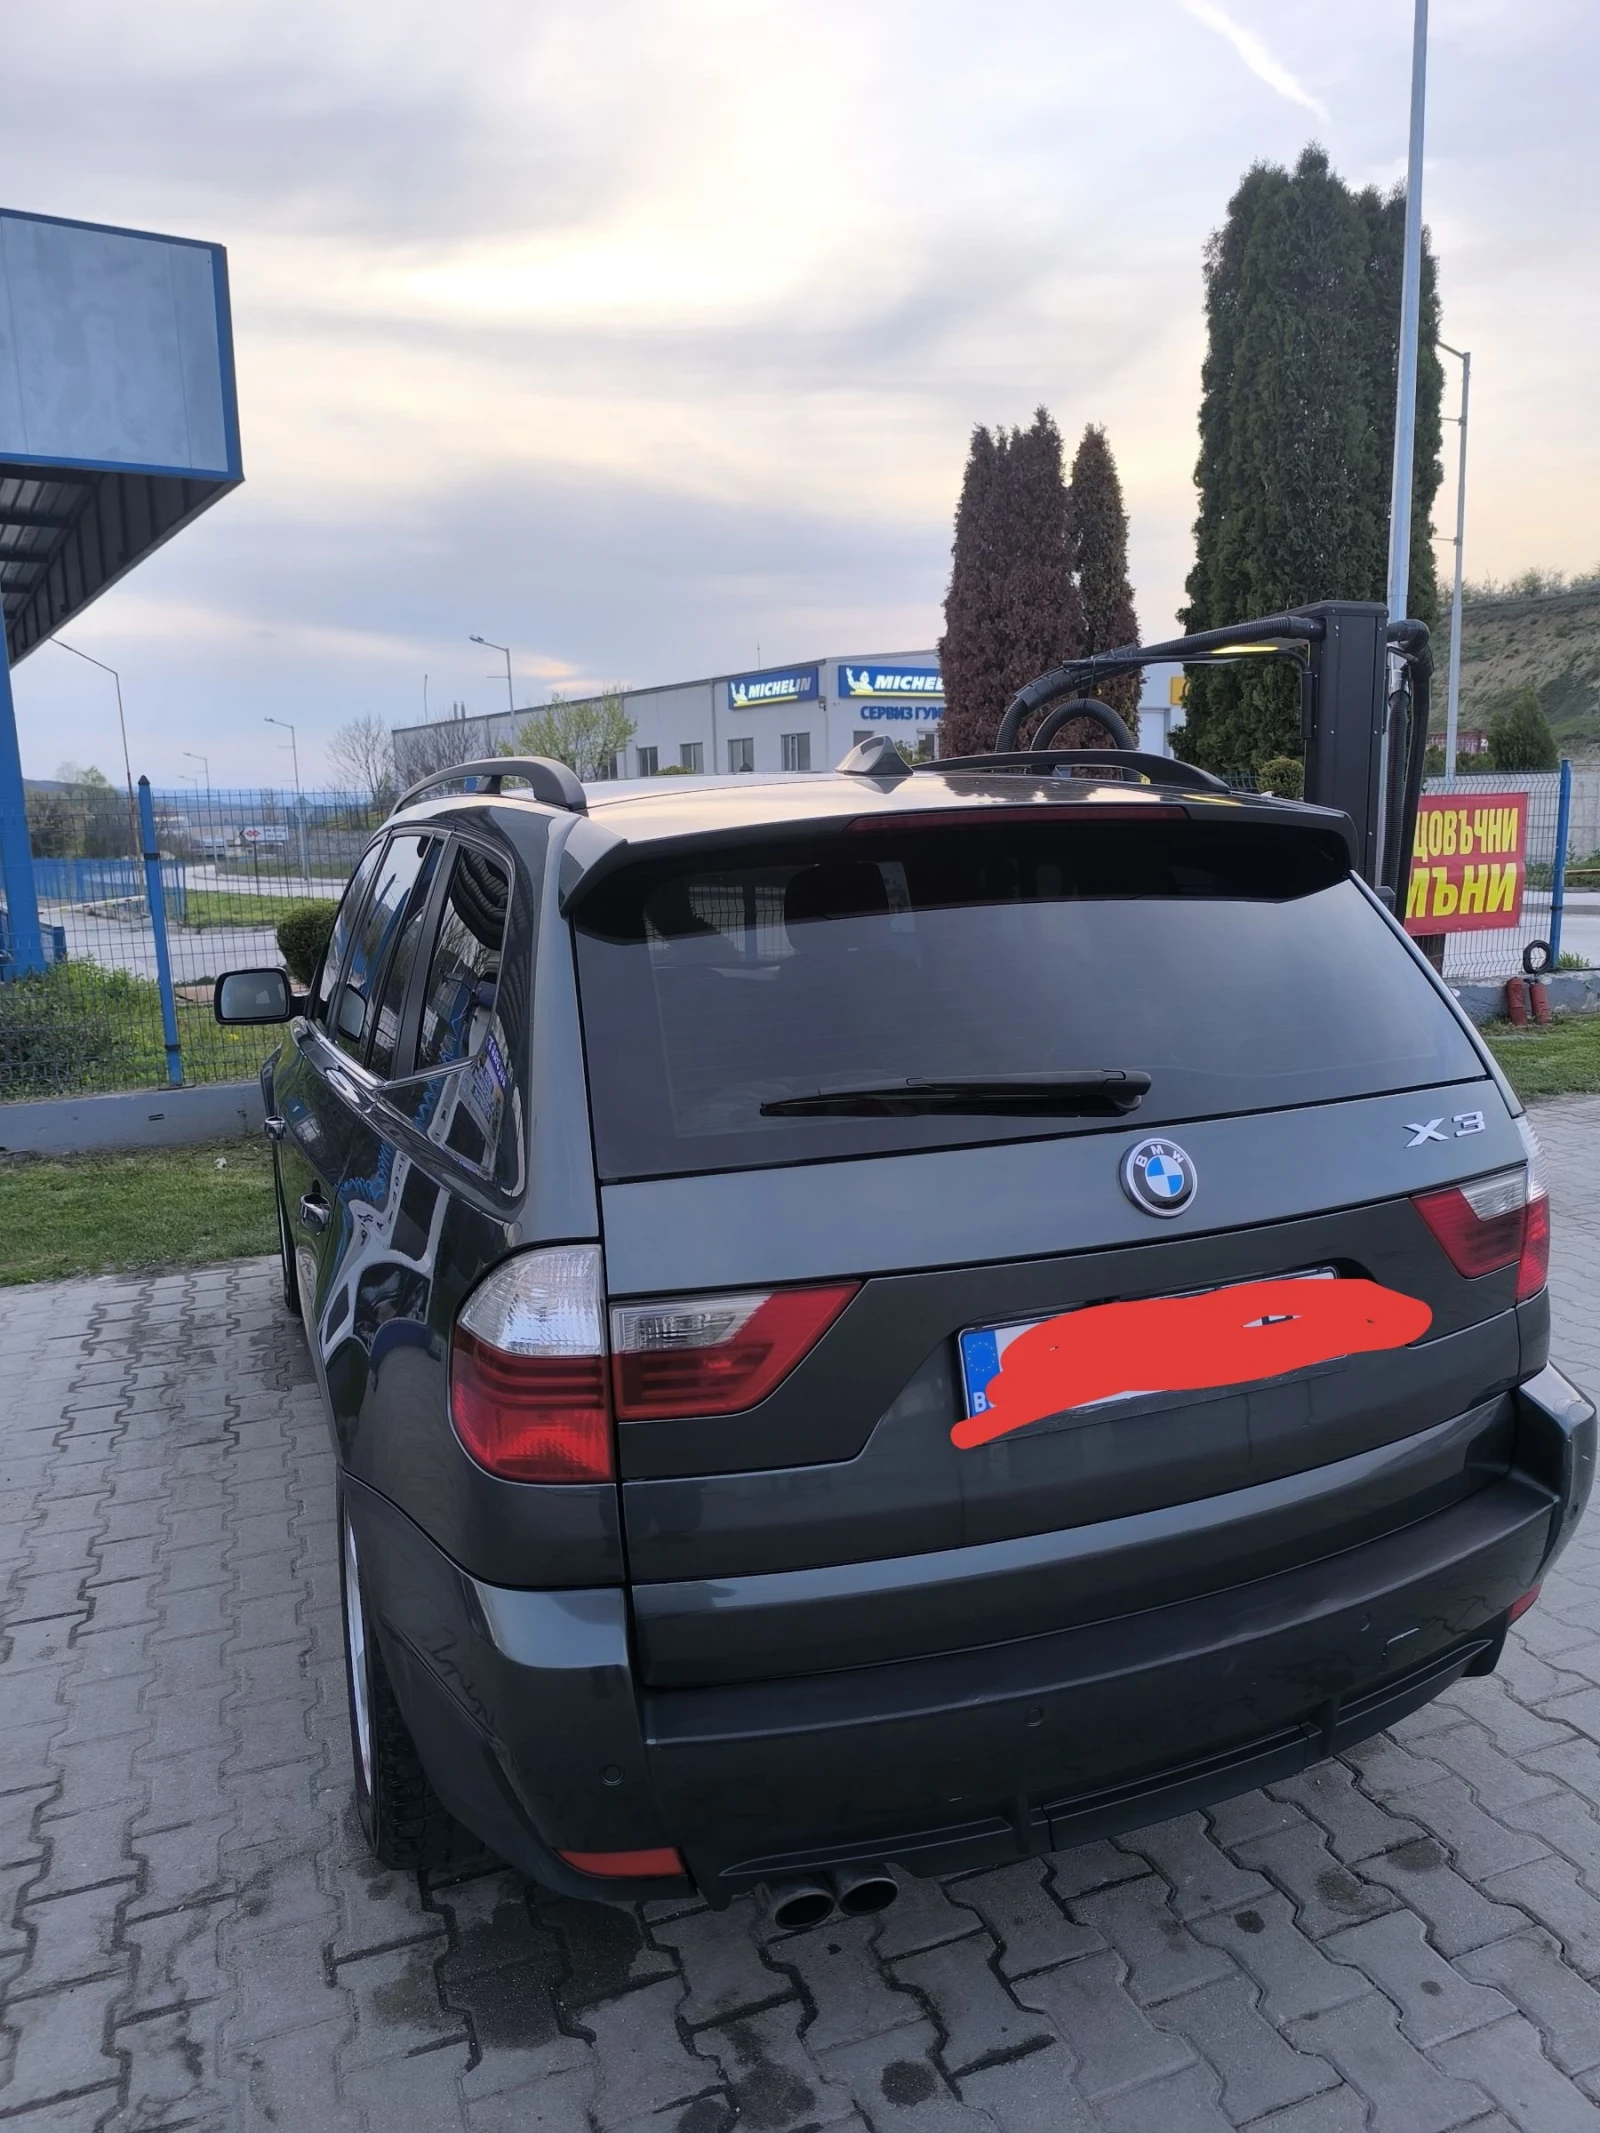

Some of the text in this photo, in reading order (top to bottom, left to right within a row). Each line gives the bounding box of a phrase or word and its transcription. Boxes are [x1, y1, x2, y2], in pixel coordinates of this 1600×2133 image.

[748, 677, 811, 699] MICHELIN
[860, 705, 913, 720] СЕРВИЗ
[1135, 1145, 1184, 1168] BMW
